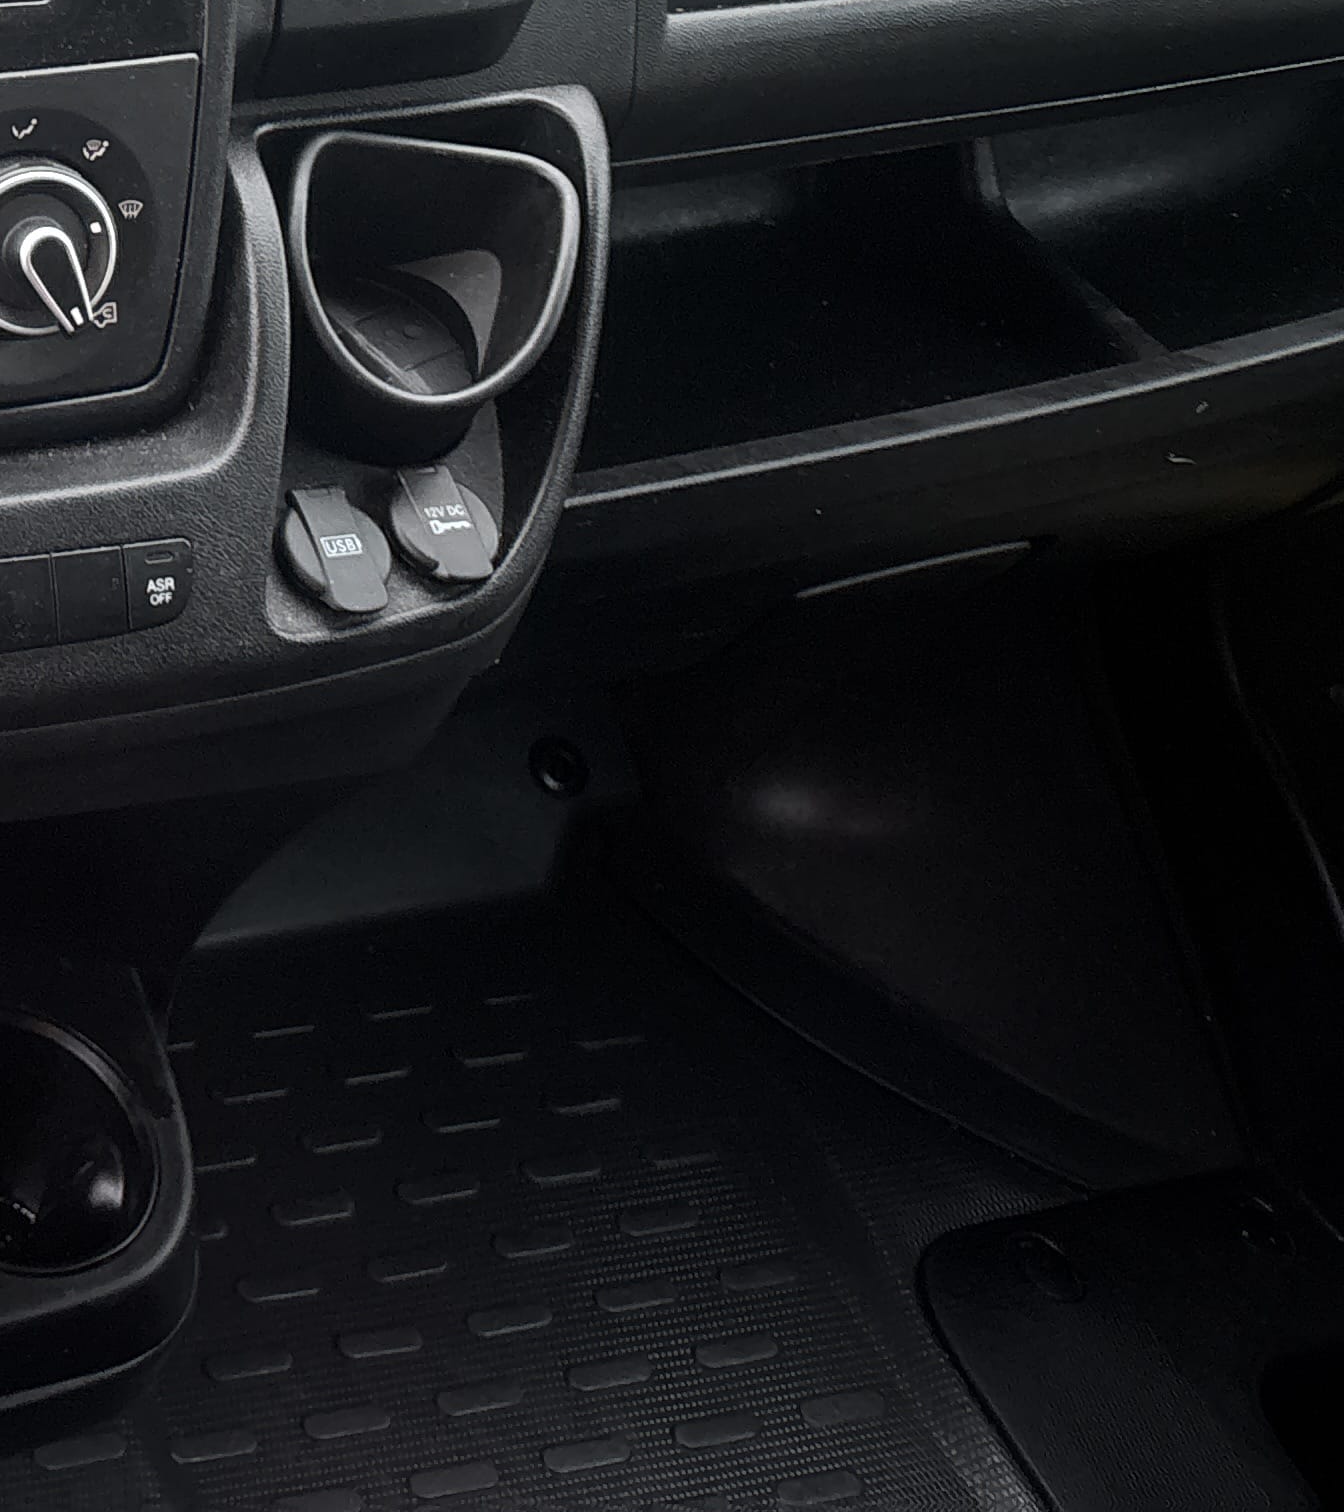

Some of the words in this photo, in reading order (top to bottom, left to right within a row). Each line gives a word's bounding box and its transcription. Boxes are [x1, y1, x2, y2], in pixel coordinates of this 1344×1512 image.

[423, 504, 445, 519] 12V
[445, 503, 466, 517] DC
[323, 538, 357, 554] USB
[146, 576, 176, 593] ASR
[149, 591, 173, 606] OFF
